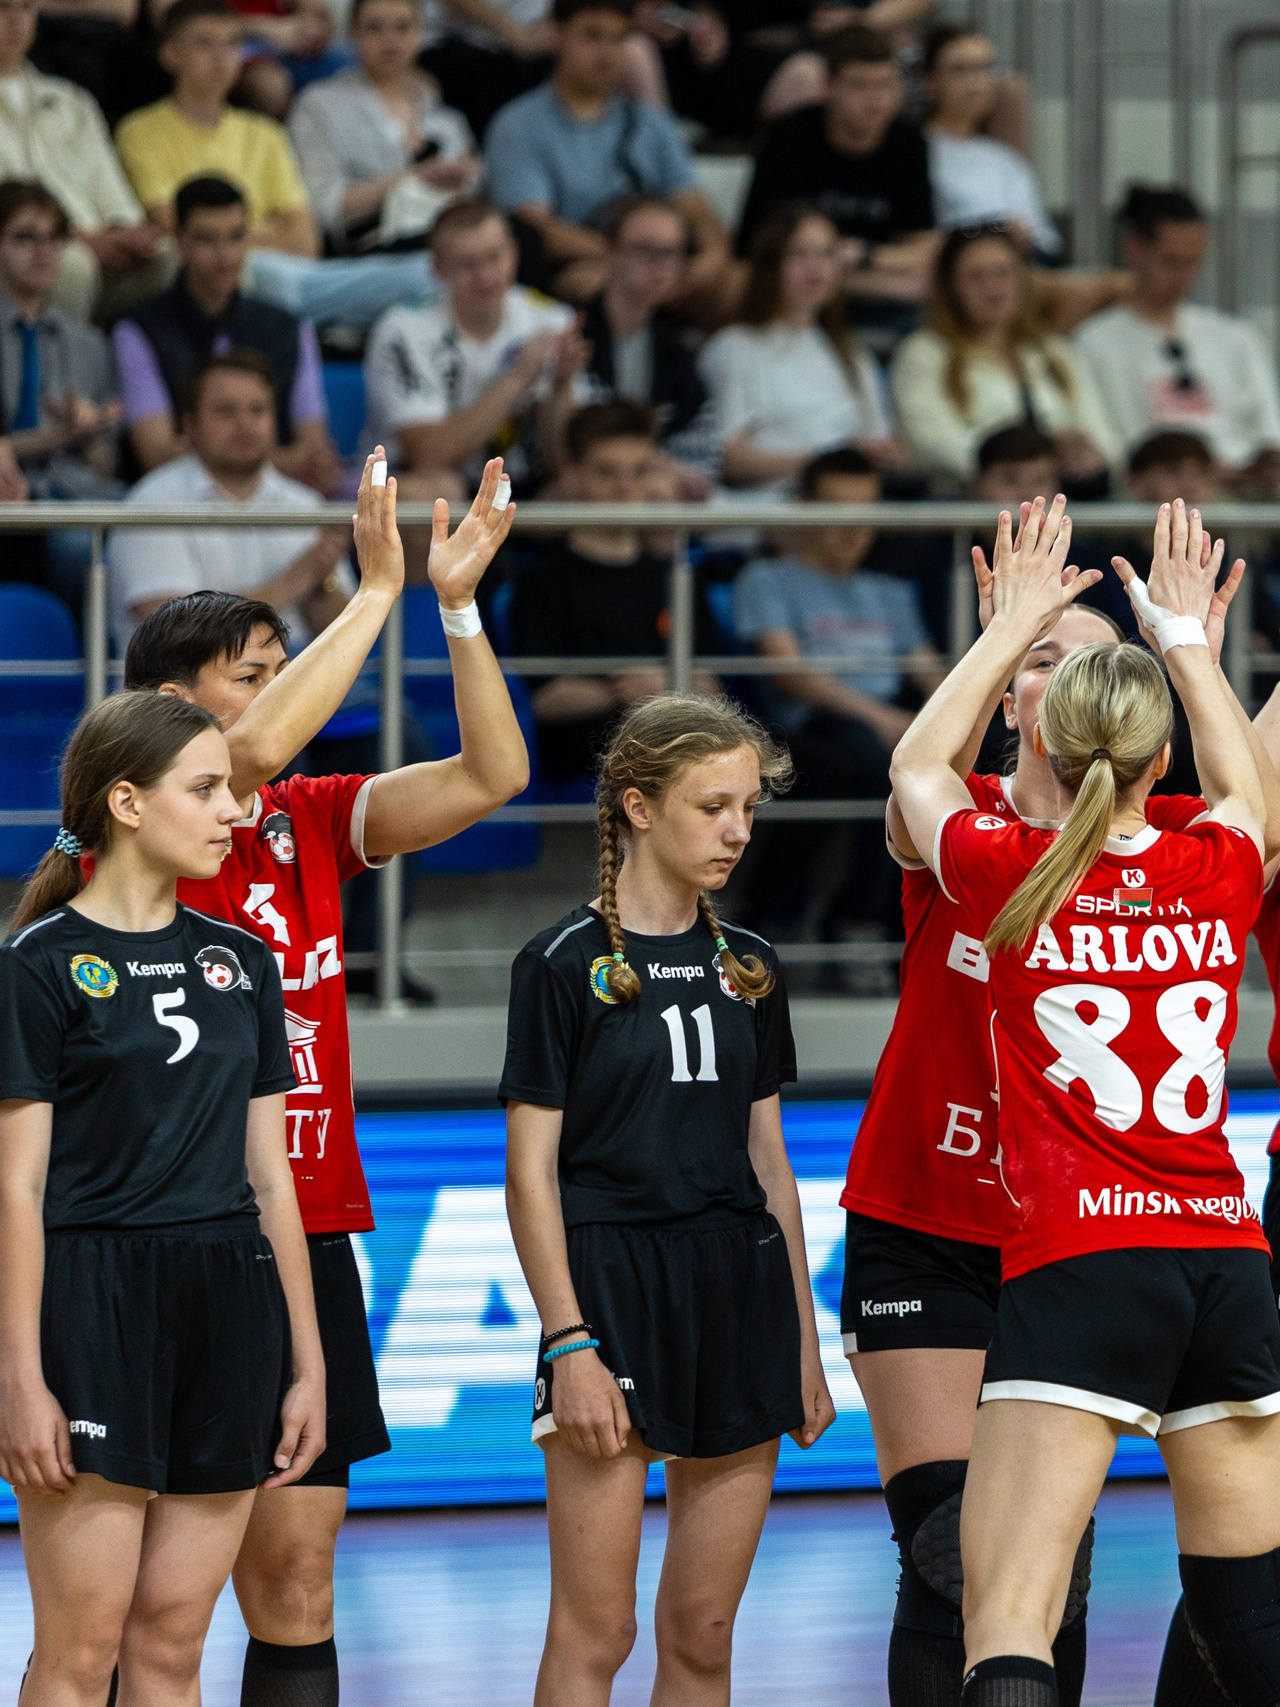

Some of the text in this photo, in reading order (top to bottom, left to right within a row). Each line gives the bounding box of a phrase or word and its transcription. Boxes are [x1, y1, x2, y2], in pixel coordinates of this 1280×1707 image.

[1025, 919, 1237, 973] ARLOVA
[126, 961, 186, 979] Kempa
[647, 963, 705, 981] Kempa
[152, 987, 199, 1064] 5
[660, 1004, 719, 1082] 11
[1033, 980, 1228, 1134] 88
[1079, 1184, 1182, 1218] Minsk
[861, 1300, 922, 1317] Kempa
[70, 1420, 107, 1439] empa
